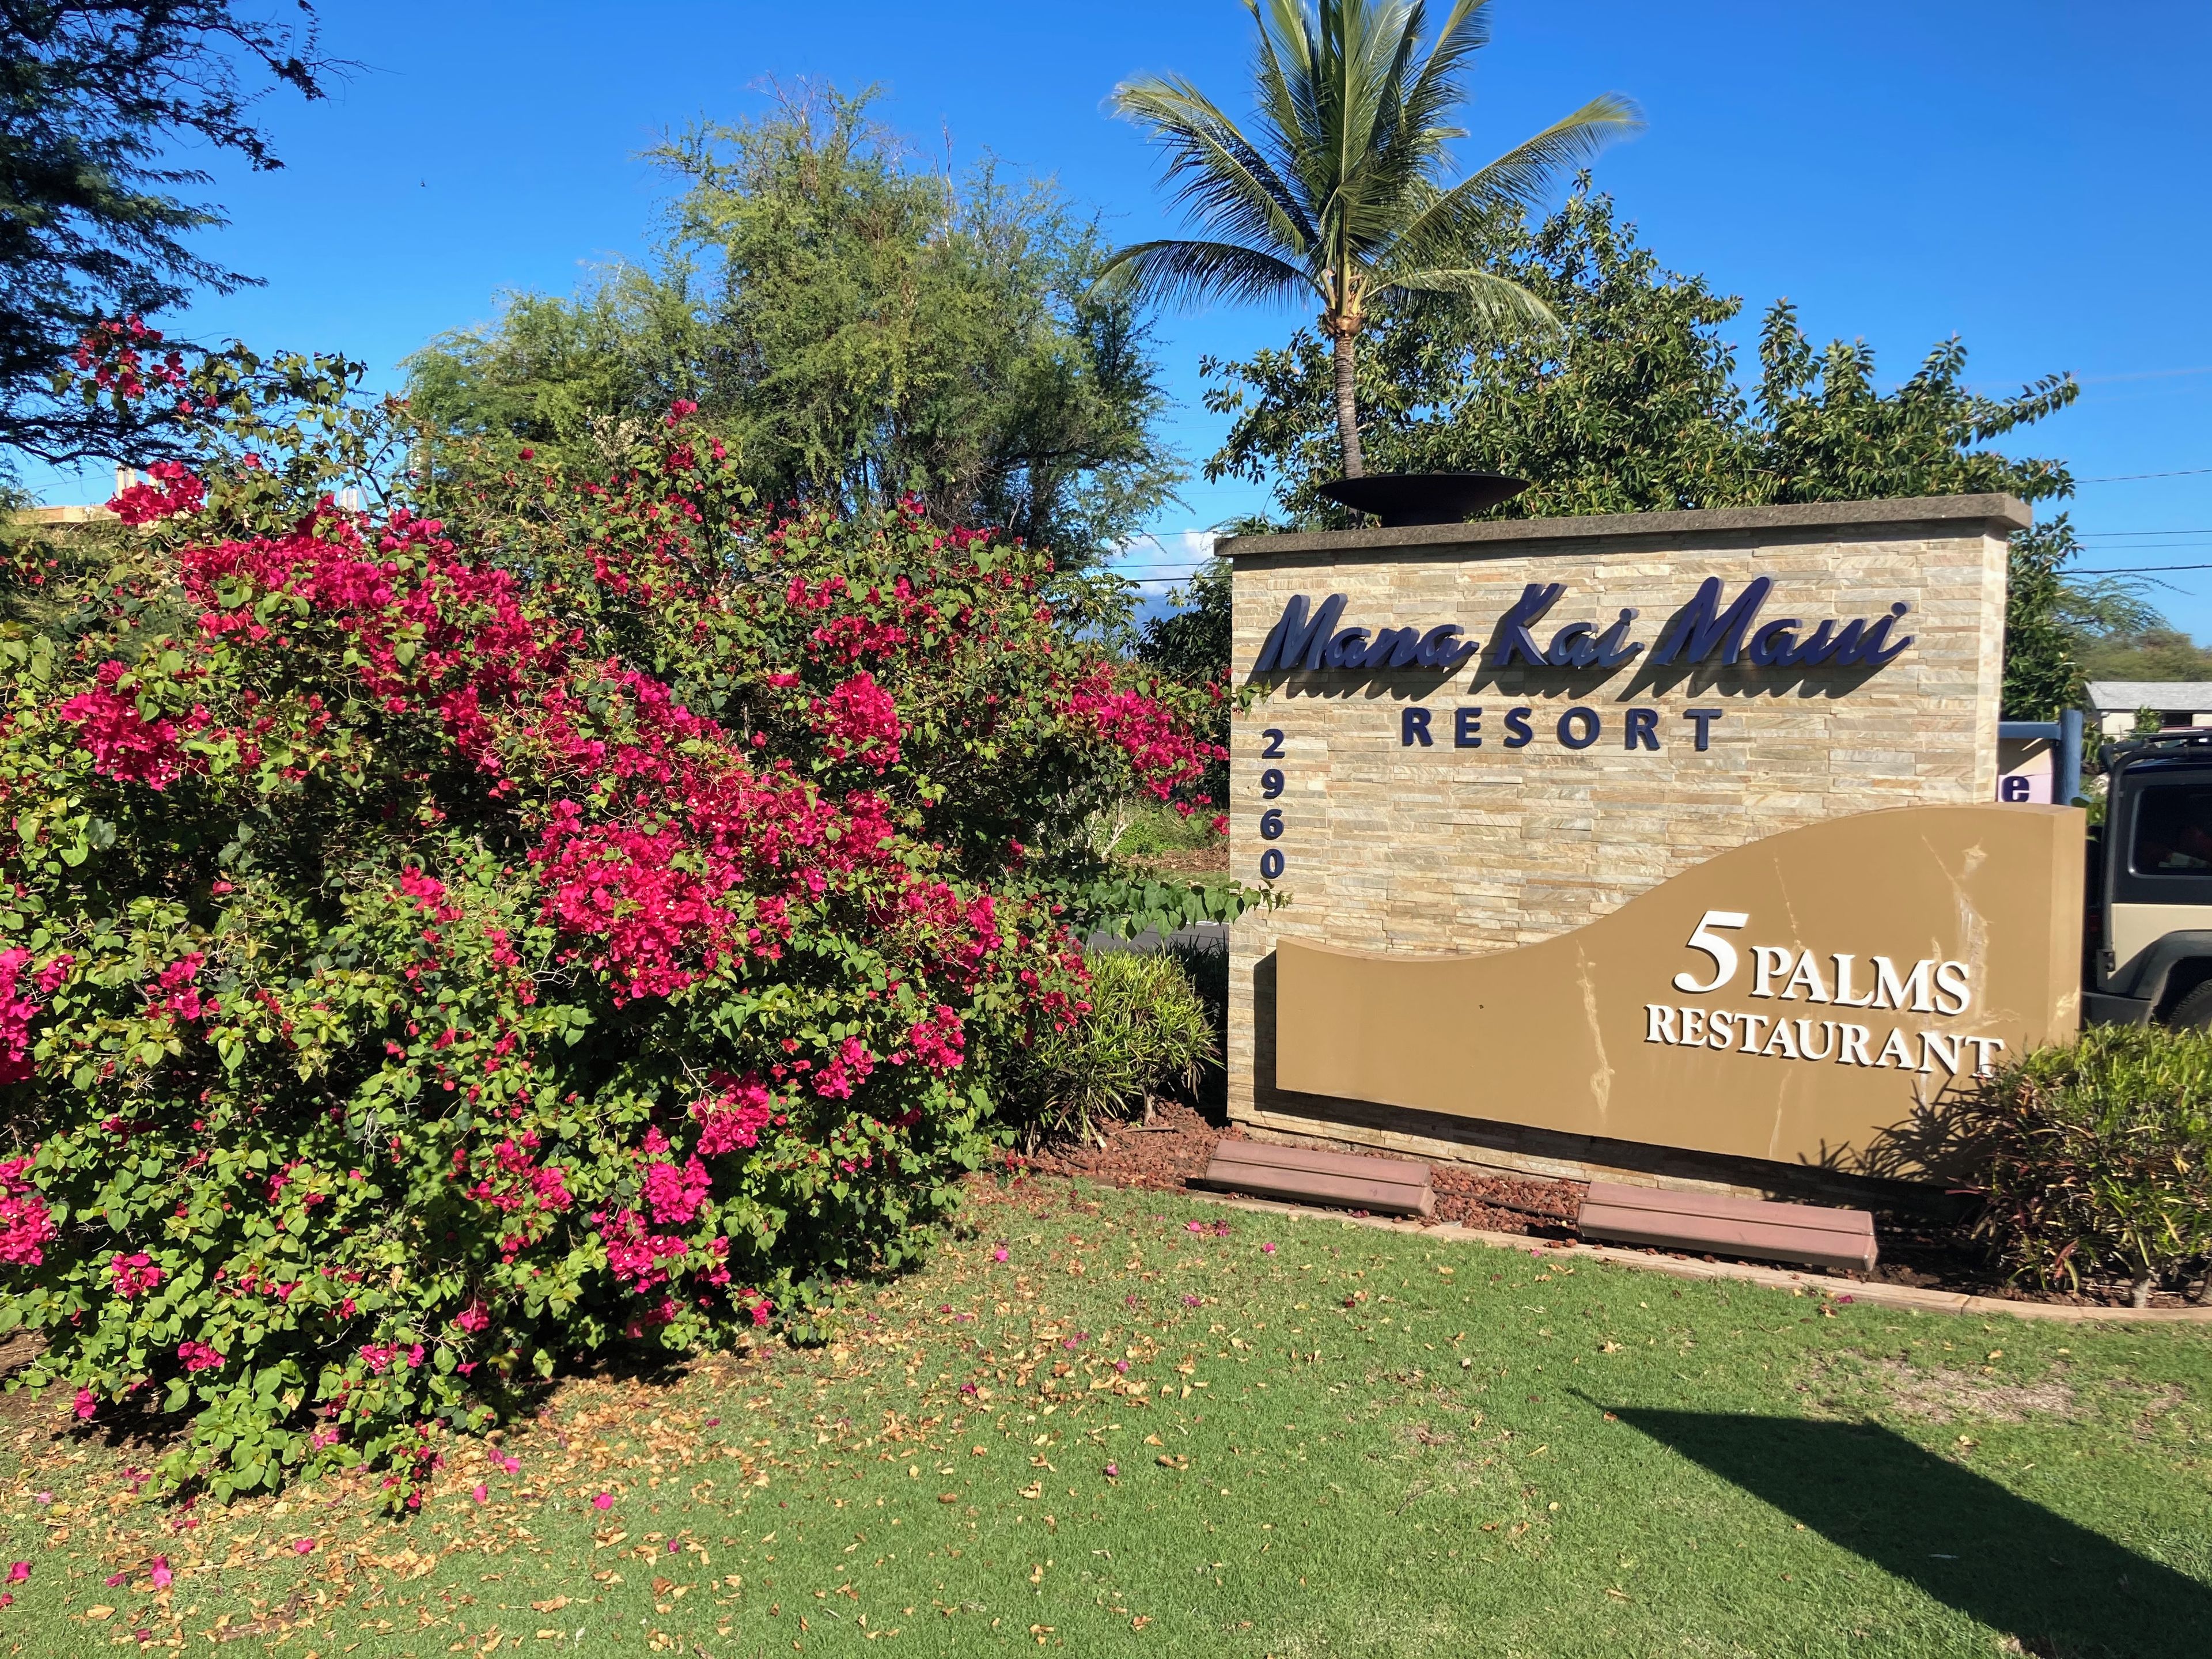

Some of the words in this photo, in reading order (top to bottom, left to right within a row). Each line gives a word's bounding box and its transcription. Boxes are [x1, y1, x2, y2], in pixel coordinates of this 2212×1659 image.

[1257, 593, 1479, 672] Mana
[1493, 584, 1645, 667] Kai
[1650, 576, 1914, 666] Maui
[1402, 707, 1723, 751] RESORT
[1261, 729, 1285, 878] 2960
[1673, 910, 1749, 994] 5
[1750, 945, 1971, 1016] PALMS
[1644, 1003, 2005, 1079] RESTAURANT
